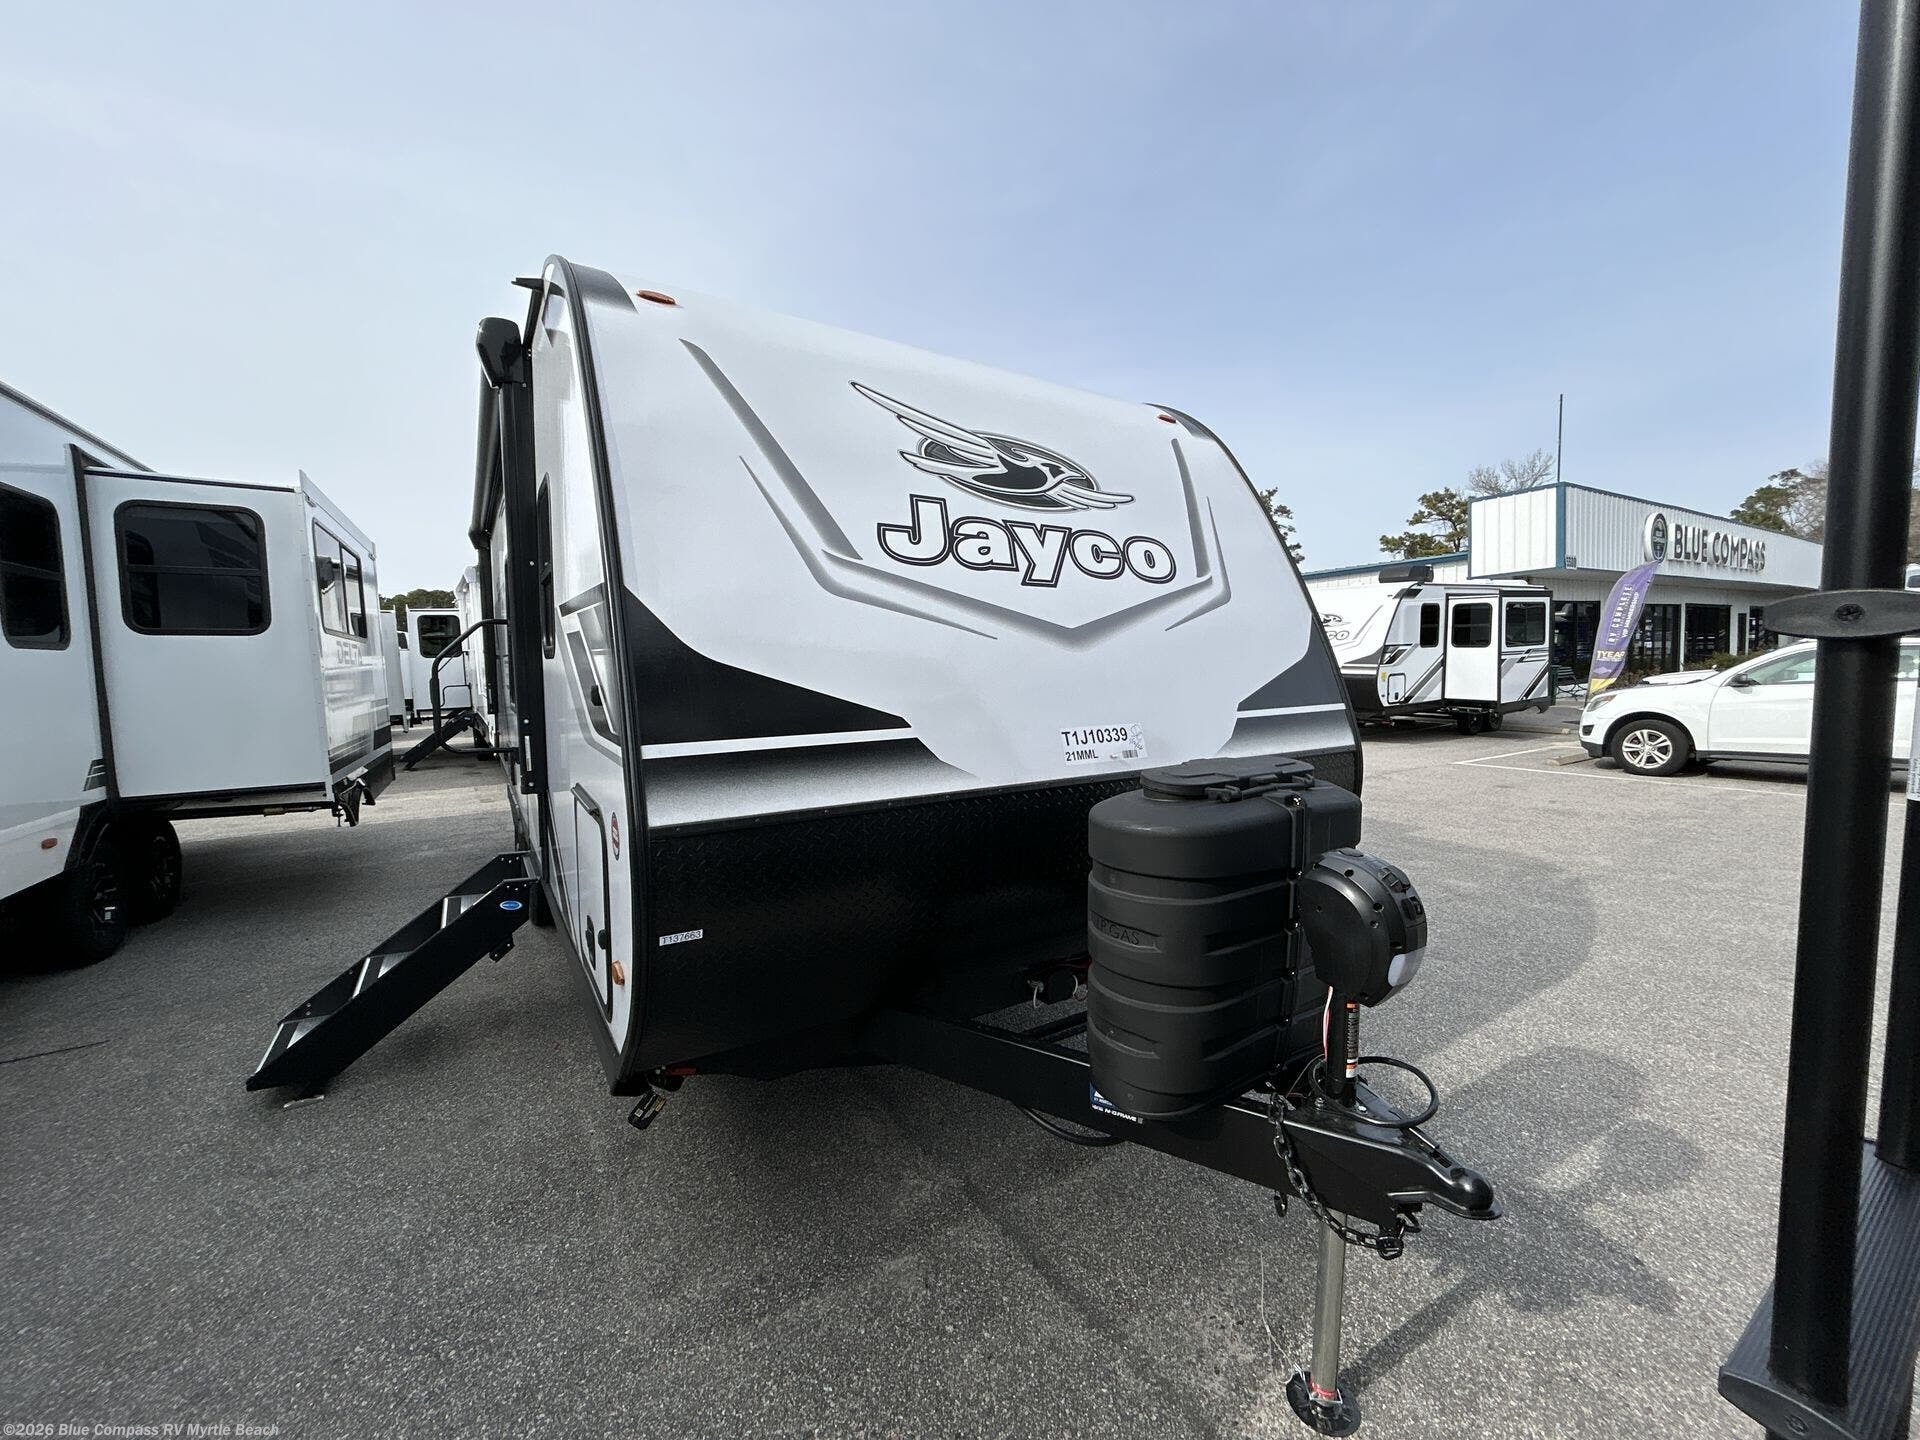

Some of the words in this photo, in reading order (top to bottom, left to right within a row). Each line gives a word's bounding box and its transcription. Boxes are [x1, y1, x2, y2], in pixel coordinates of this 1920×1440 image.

[877, 494, 1177, 588] Jayco
[1673, 524, 1708, 562] BLUE
[1712, 532, 1766, 570] COMPASS
[1612, 585, 1633, 628] COMPLETE
[1061, 727, 1128, 747] T1J10339
[1065, 749, 1099, 761] 21MML
[1109, 924, 1139, 945] GAS
